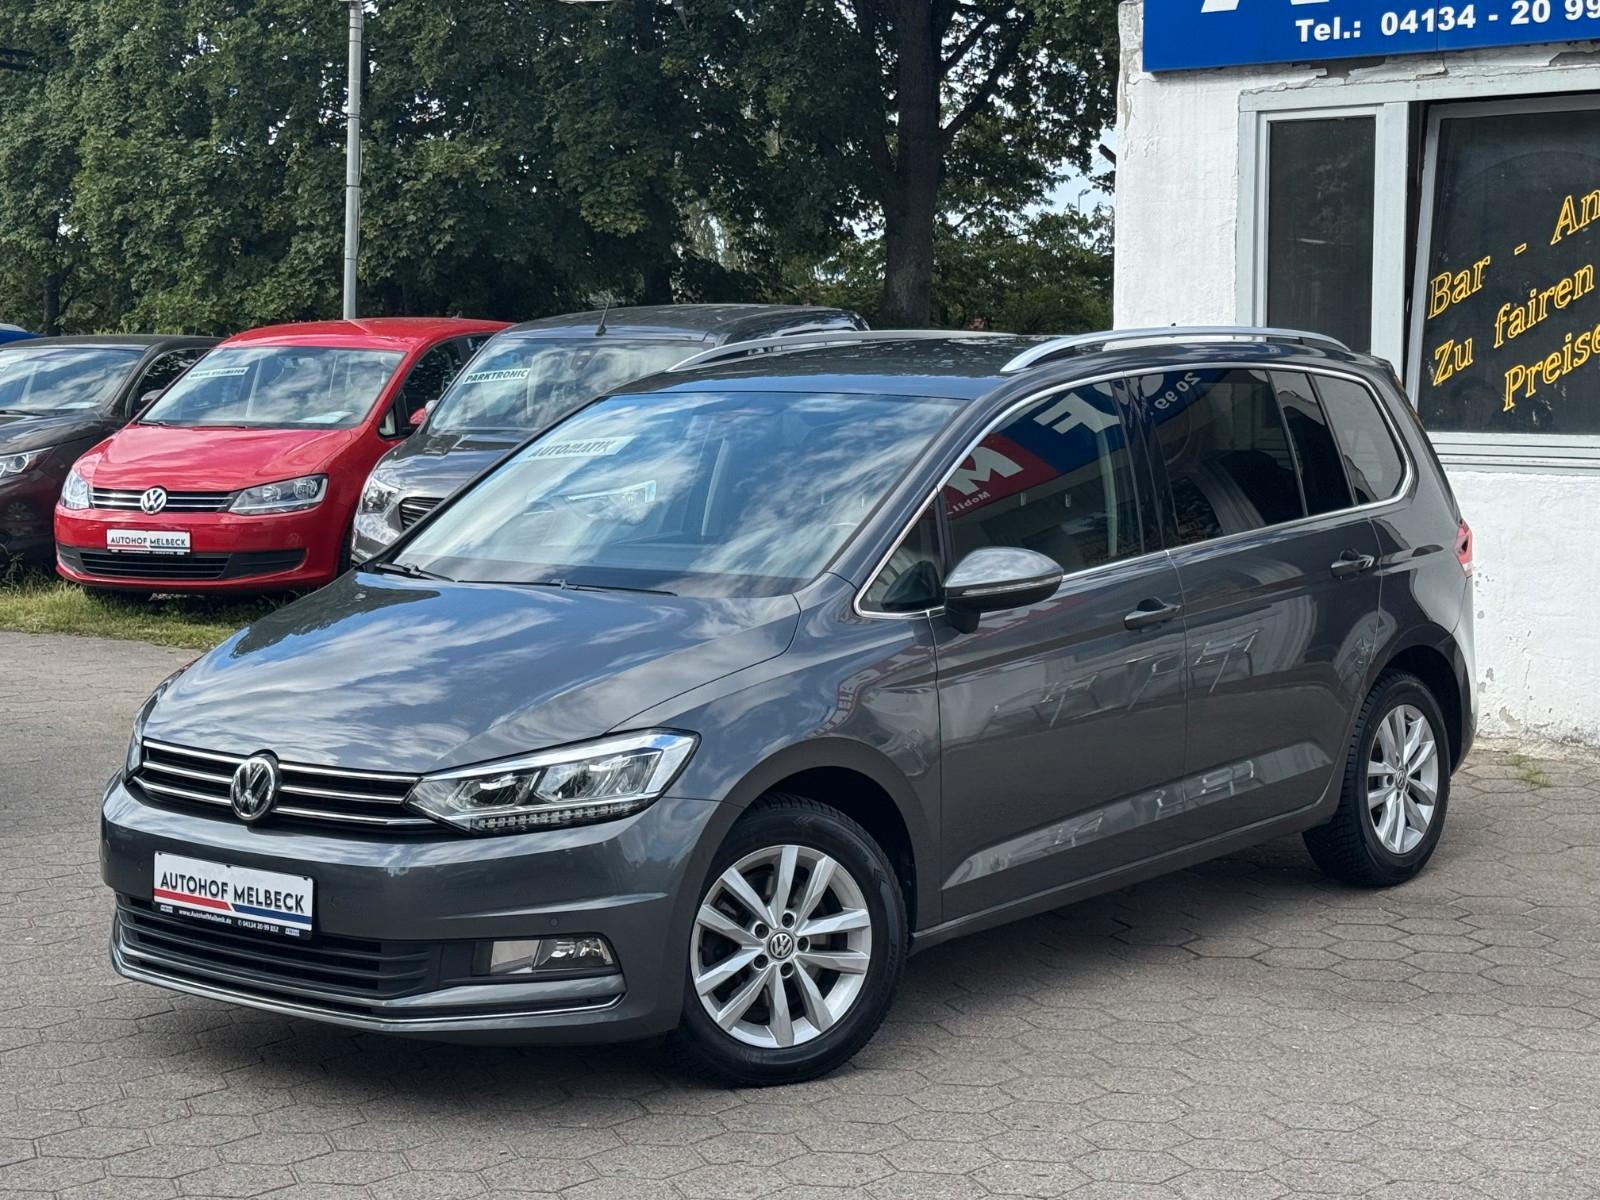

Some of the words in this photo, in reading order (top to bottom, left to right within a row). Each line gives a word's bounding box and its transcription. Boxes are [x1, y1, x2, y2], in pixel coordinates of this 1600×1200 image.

[1295, 20, 1361, 42] Tel.:
[1381, 4, 1476, 36] 04134
[1510, 0, 1551, 25] 20
[1564, 0, 1600, 21] 99
[1428, 255, 1490, 320] Bar
[1433, 338, 1474, 386] Zu
[1493, 264, 1595, 349] fairen
[464, 369, 528, 383] PARKTRONIC
[527, 440, 617, 458] AUTOMATIK
[110, 536, 148, 545] AUTOHOF
[149, 538, 186, 546] MELBECK
[160, 871, 229, 900] AUTOHOF
[233, 884, 305, 914] MELBECK
